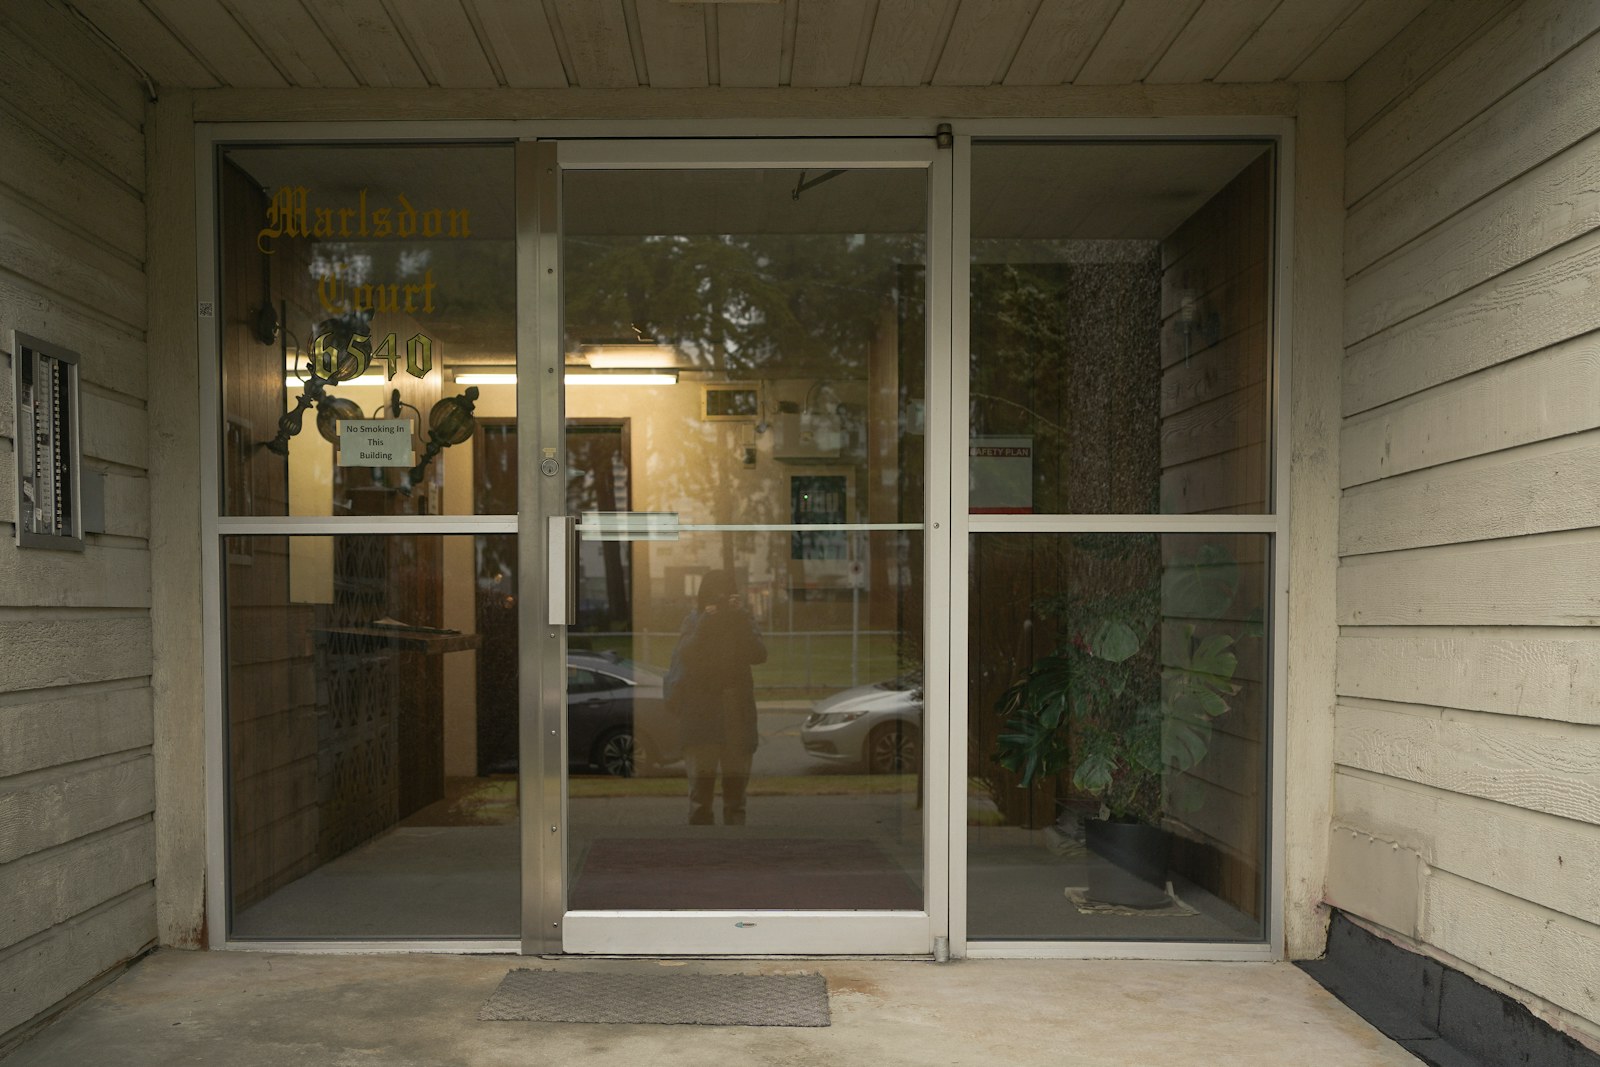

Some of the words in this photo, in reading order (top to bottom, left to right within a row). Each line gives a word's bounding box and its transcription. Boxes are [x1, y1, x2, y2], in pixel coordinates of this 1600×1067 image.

[257, 184, 473, 254] Marlsdon
[317, 263, 438, 314] Court
[313, 332, 433, 381] 6540
[346, 425, 359, 433] No
[360, 425, 395, 435] Smoking
[396, 425, 405, 433] In
[367, 438, 384, 446] This
[359, 452, 393, 461] Building
[1005, 448, 1029, 456] PLAN
